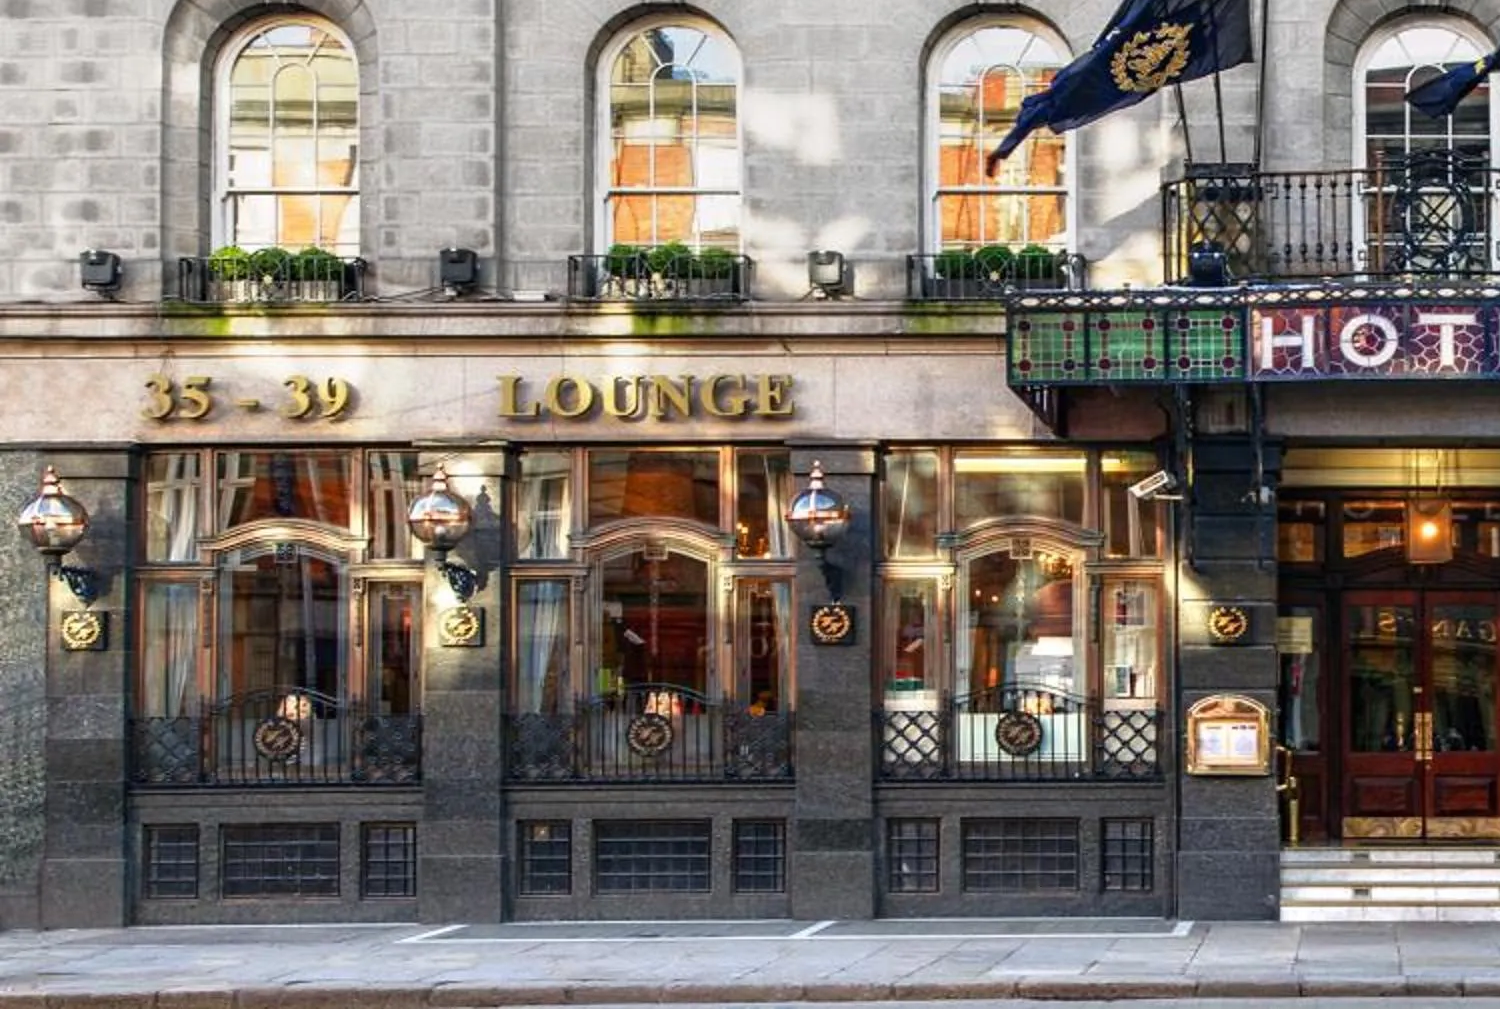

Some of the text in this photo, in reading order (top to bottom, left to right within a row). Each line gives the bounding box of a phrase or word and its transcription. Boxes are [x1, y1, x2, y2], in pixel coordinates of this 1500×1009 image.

[141, 374, 212, 419] 35
[282, 375, 352, 420] 39
[496, 374, 797, 418] LOUNGE
